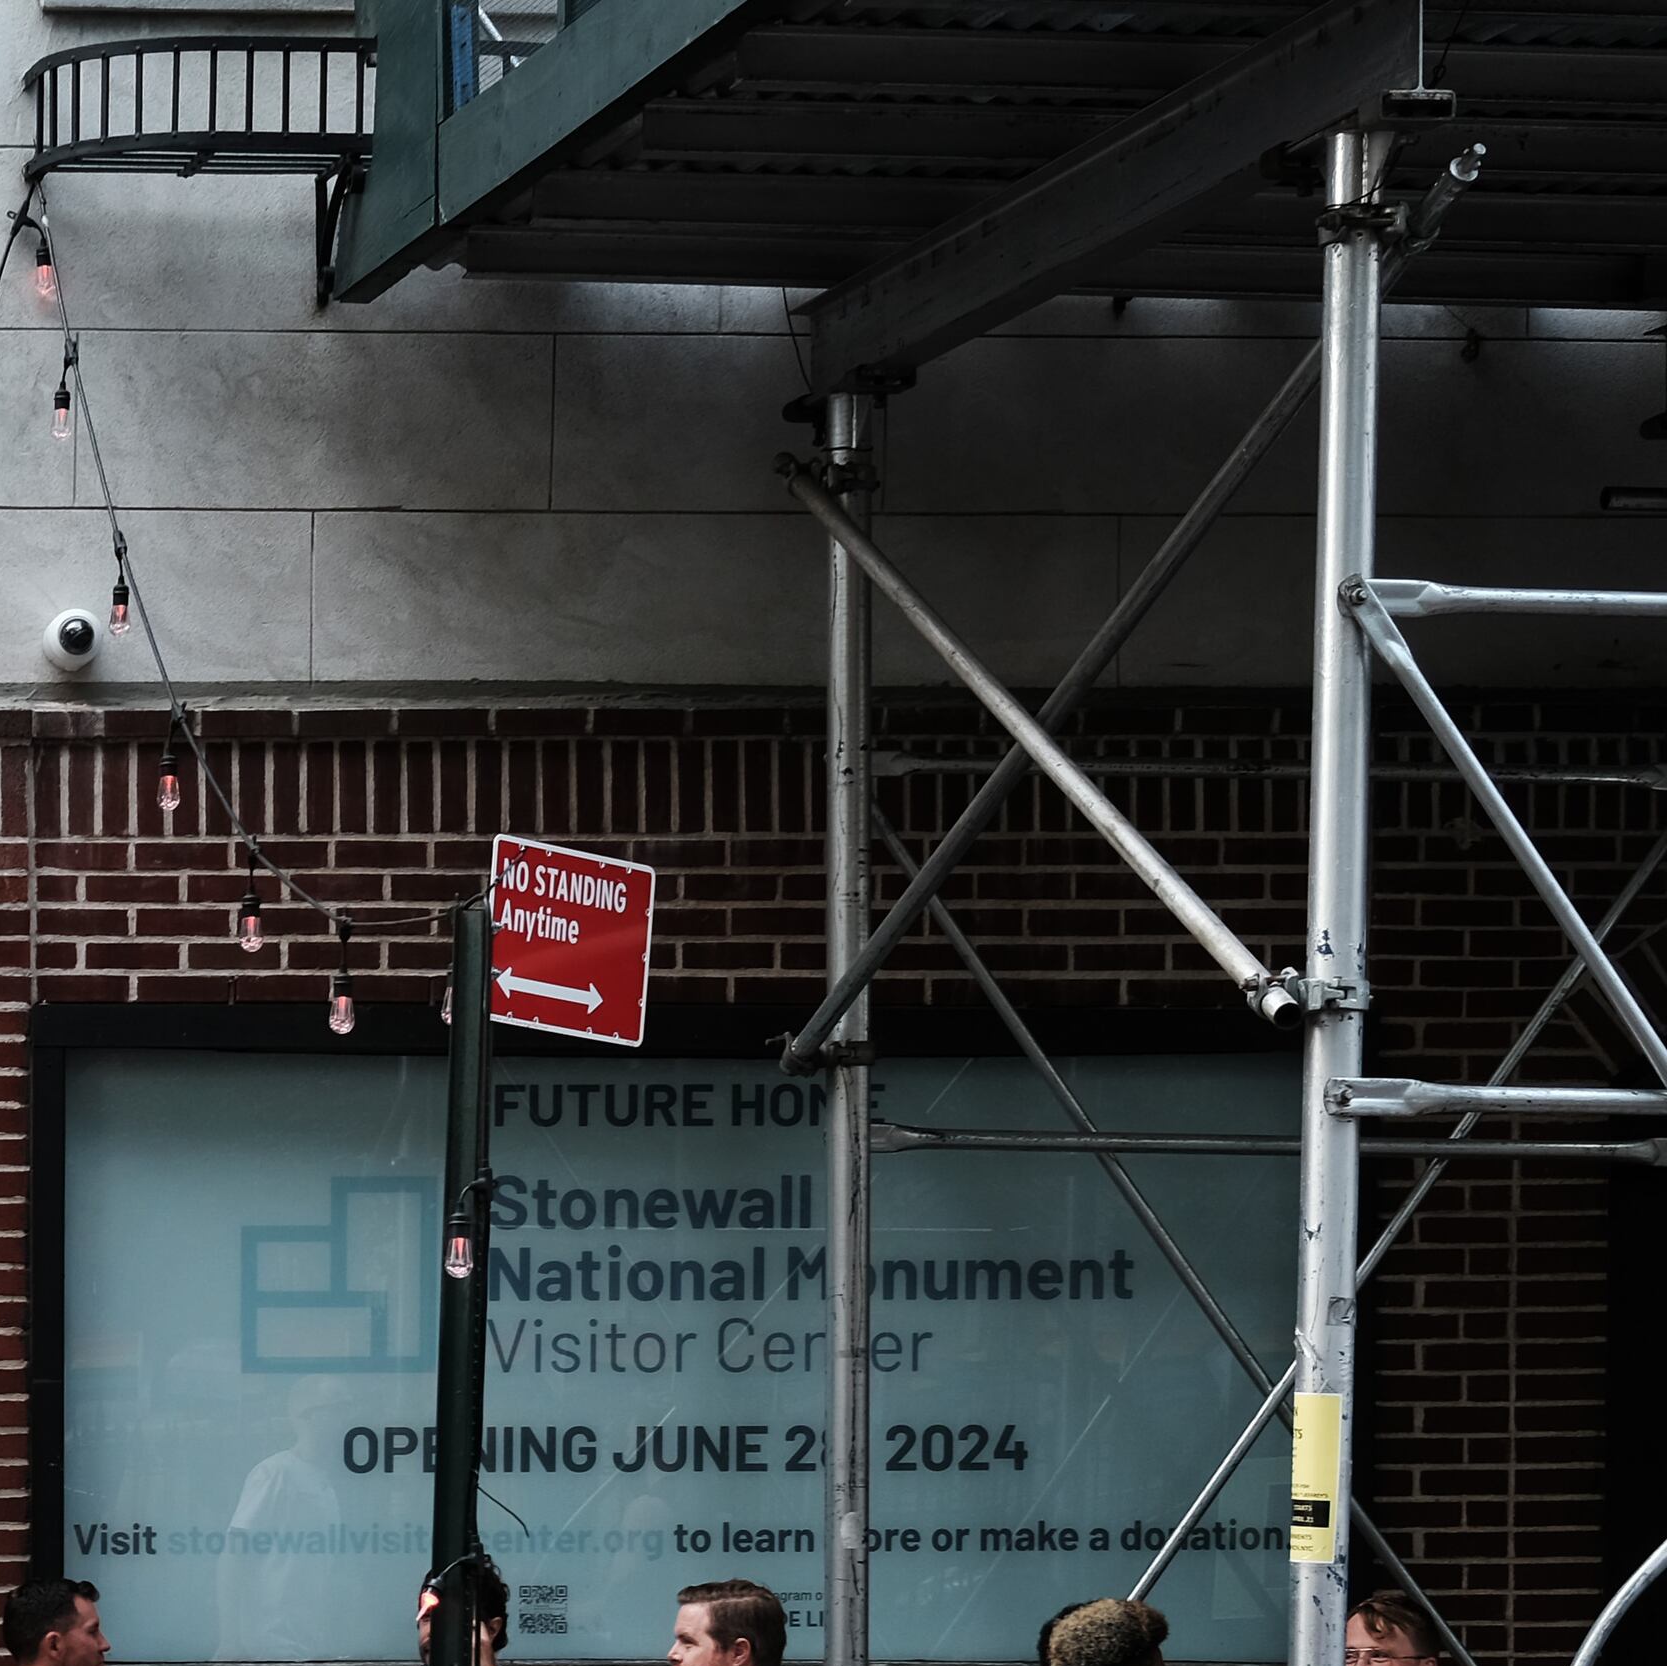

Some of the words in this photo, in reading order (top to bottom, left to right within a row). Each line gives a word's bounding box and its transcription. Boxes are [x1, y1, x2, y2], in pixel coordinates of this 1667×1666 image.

[502, 858, 529, 892] NO
[534, 864, 627, 913] STANDING
[501, 899, 579, 944] Anytime
[495, 1084, 714, 1126] FUTURE
[491, 1175, 812, 1230] Stonewall
[488, 1245, 765, 1302] National
[788, 1246, 1134, 1302] Mnument
[488, 1318, 696, 1374] Visitor
[719, 1318, 932, 1374] Cener
[613, 1425, 768, 1472] JUNE
[885, 1425, 1028, 1472] 2024
[73, 1523, 157, 1556] Visit
[675, 1522, 711, 1552] to
[723, 1520, 814, 1552] learn
[932, 1528, 969, 1553] or
[980, 1524, 1079, 1553] make
[1089, 1529, 1109, 1552] a
